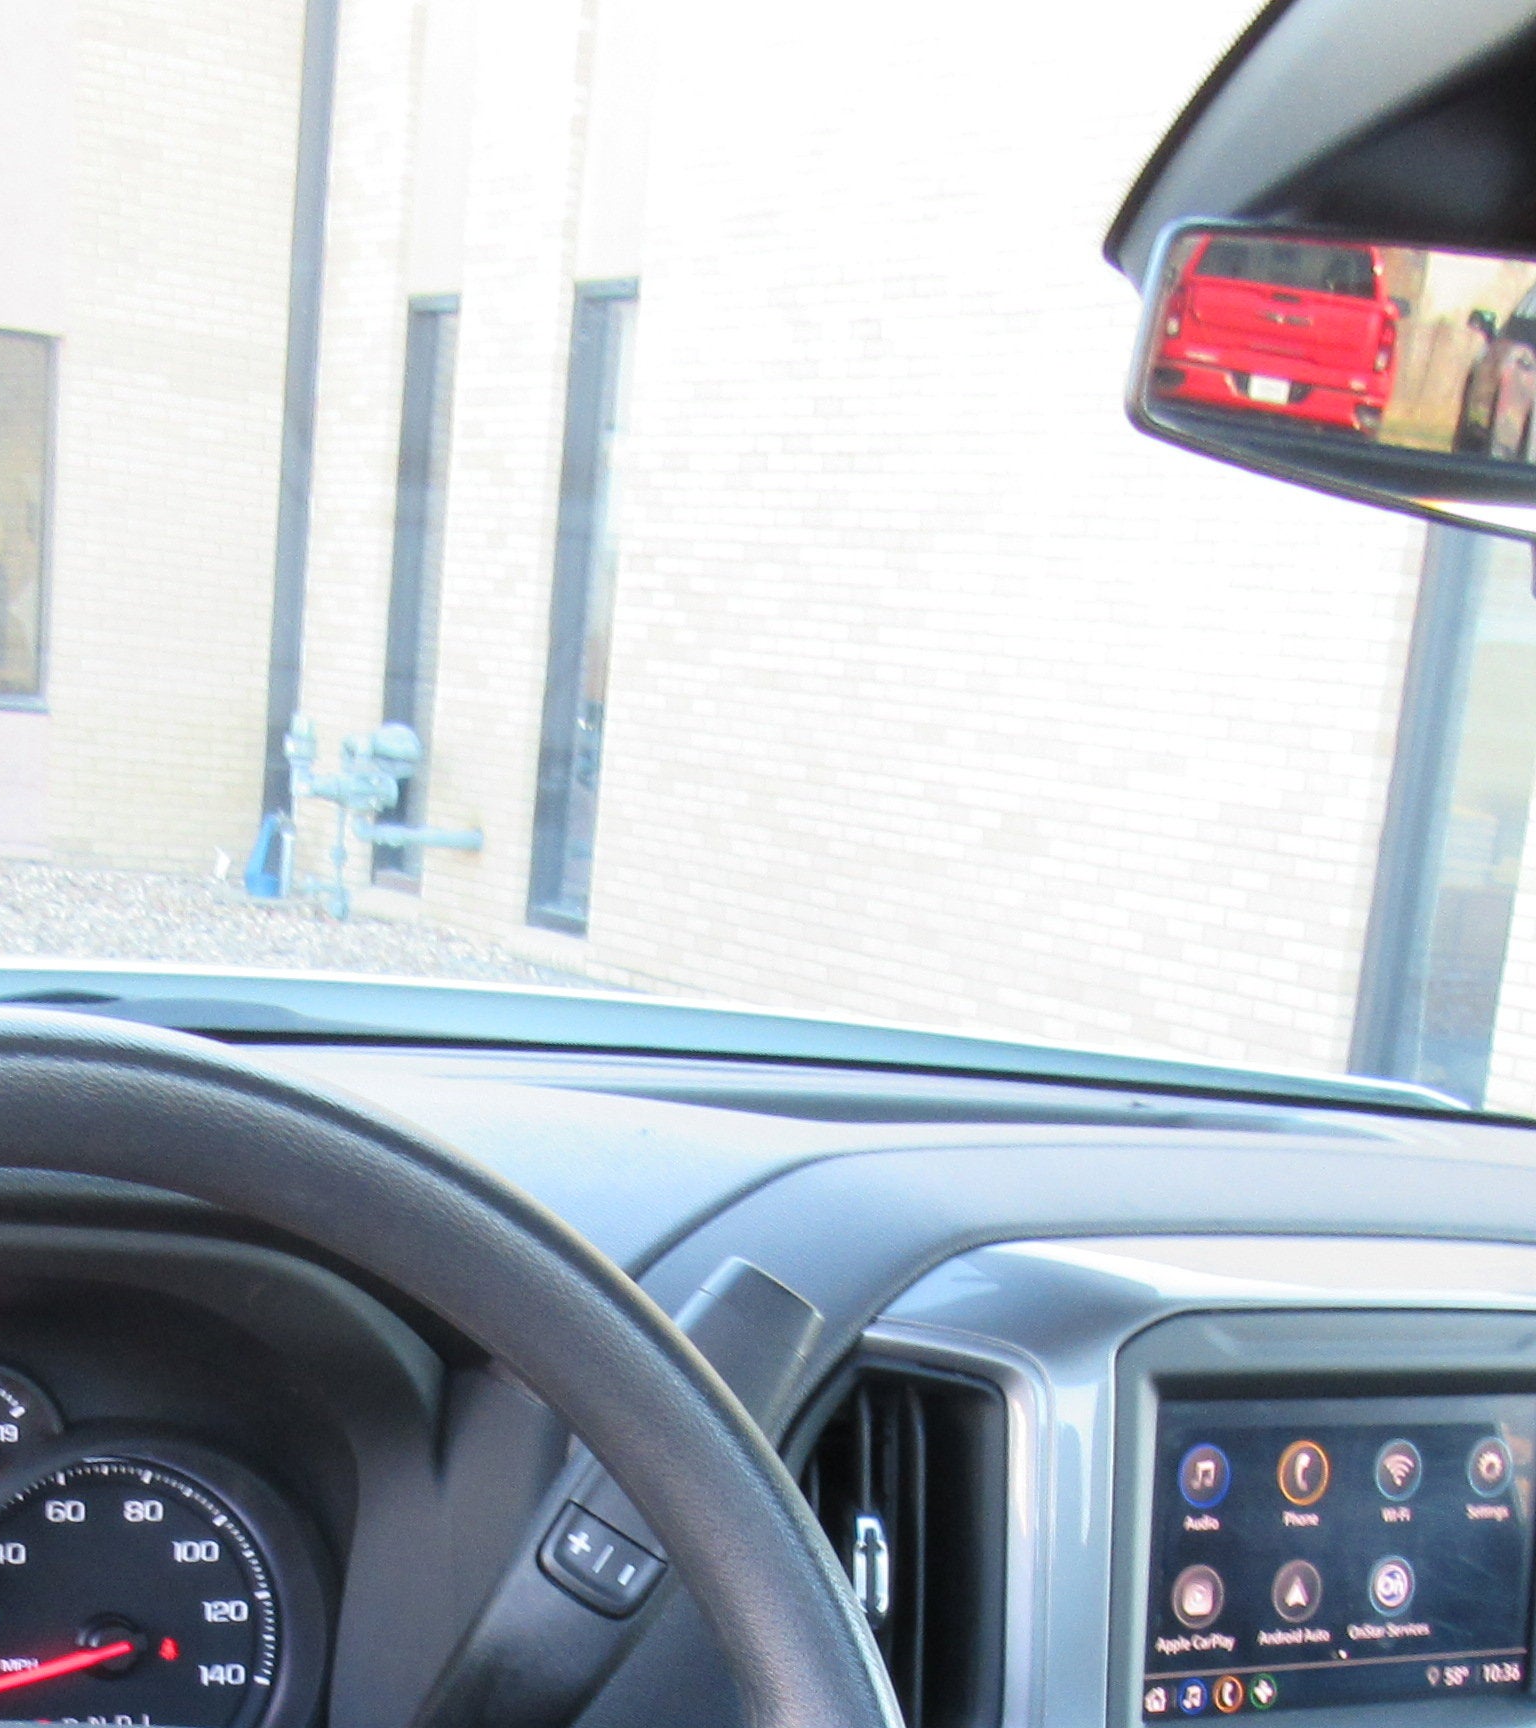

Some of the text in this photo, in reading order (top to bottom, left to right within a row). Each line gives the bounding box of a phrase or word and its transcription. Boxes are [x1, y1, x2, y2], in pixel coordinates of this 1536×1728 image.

[45, 1500, 86, 1524] 60
[123, 1500, 163, 1523] 80
[1183, 1515, 1220, 1531] Audio
[1282, 1511, 1319, 1527] Phone
[172, 1540, 219, 1564] 100
[203, 1601, 248, 1624] 120
[1156, 1635, 1235, 1655] Apple CarPlay
[1257, 1628, 1330, 1646] Android Auto
[198, 1663, 246, 1687] 140
